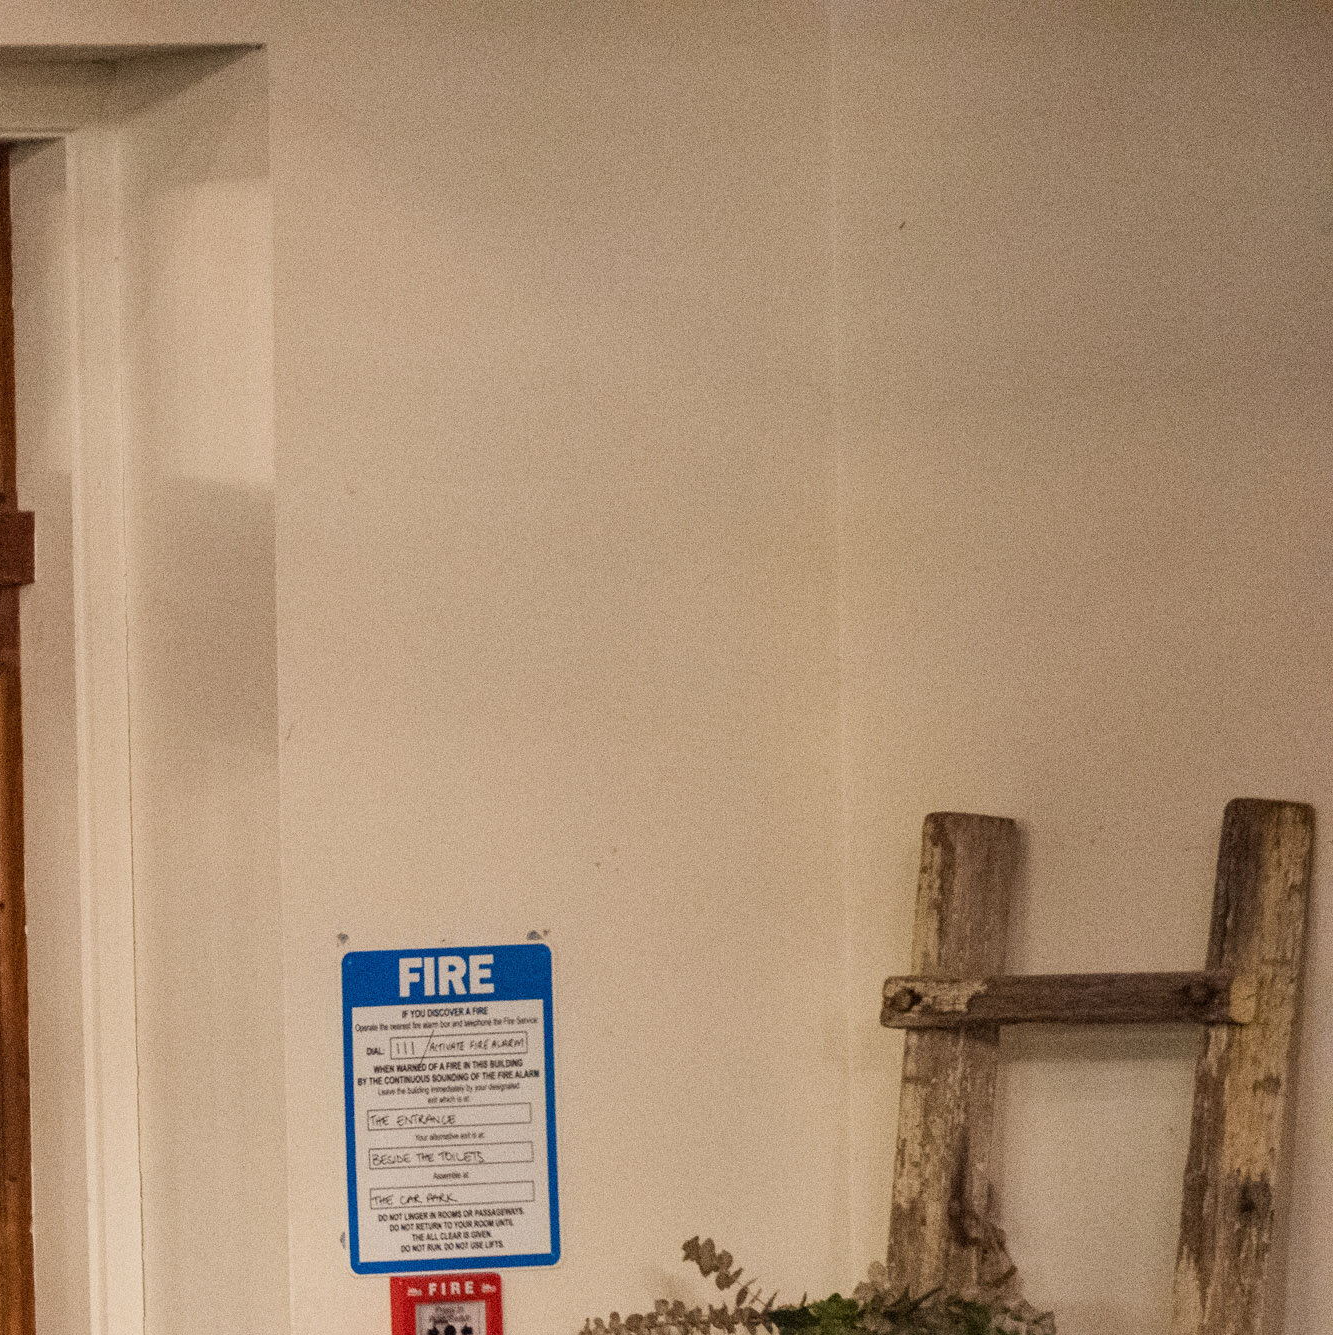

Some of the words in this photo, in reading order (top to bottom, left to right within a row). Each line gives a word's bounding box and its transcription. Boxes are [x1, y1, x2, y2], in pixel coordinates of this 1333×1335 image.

[399, 954, 494, 997] FIRE
[410, 1009, 425, 1018] YOU
[427, 1007, 463, 1018] DISCOVER
[465, 1007, 470, 1015] A
[473, 1006, 488, 1015] FIRE
[396, 1041, 415, 1055] 111
[469, 1039, 489, 1050] FIRE
[492, 1038, 524, 1048] ALARM
[374, 1064, 395, 1073] WHEN
[396, 1063, 427, 1073] WARNED
[428, 1062, 438, 1071] OF
[439, 1062, 444, 1071] A
[445, 1061, 461, 1070] FIRE
[463, 1061, 470, 1069] IN
[472, 1060, 488, 1068] THIS
[490, 1058, 523, 1068] BUILDING
[357, 1077, 367, 1086] BY
[369, 1077, 382, 1085] THE
[384, 1074, 430, 1085] CONTINUOUS
[432, 1073, 469, 1082] SOUNDING
[470, 1072, 480, 1080] OF
[482, 1071, 495, 1080] THE
[497, 1070, 513, 1079] FIRE
[515, 1069, 539, 1078] ALARM
[370, 1114, 389, 1126] THE
[396, 1114, 456, 1126] ENTRANCE
[372, 1153, 411, 1166] BESIDE
[416, 1152, 434, 1162] THE
[438, 1150, 485, 1163] TOILETS
[373, 1194, 393, 1206] THE
[400, 1194, 423, 1205] CAR
[426, 1192, 458, 1203] PARK
[378, 1213, 388, 1222] DO
[389, 1212, 402, 1221] NOT
[404, 1211, 428, 1220] LINGER
[430, 1211, 436, 1219] IN
[438, 1210, 462, 1219] ROOMS
[463, 1209, 473, 1218] OR
[390, 1224, 399, 1232] DO
[416, 1222, 442, 1230] RETURN
[444, 1221, 453, 1229] TO
[454, 1220, 473, 1229] YOUR
[474, 1219, 494, 1228] ROOM
[495, 1218, 513, 1227] UNTIL
[412, 1233, 425, 1241] THE
[426, 1232, 438, 1240] ALL
[440, 1231, 462, 1240] CLEAR
[463, 1231, 469, 1239] IS
[400, 1245, 410, 1253] DO
[412, 1244, 425, 1252] NOT
[444, 1242, 454, 1251] DO
[455, 1241, 468, 1250] NOT
[471, 1241, 483, 1249] USE
[428, 1281, 474, 1296] FIRE
